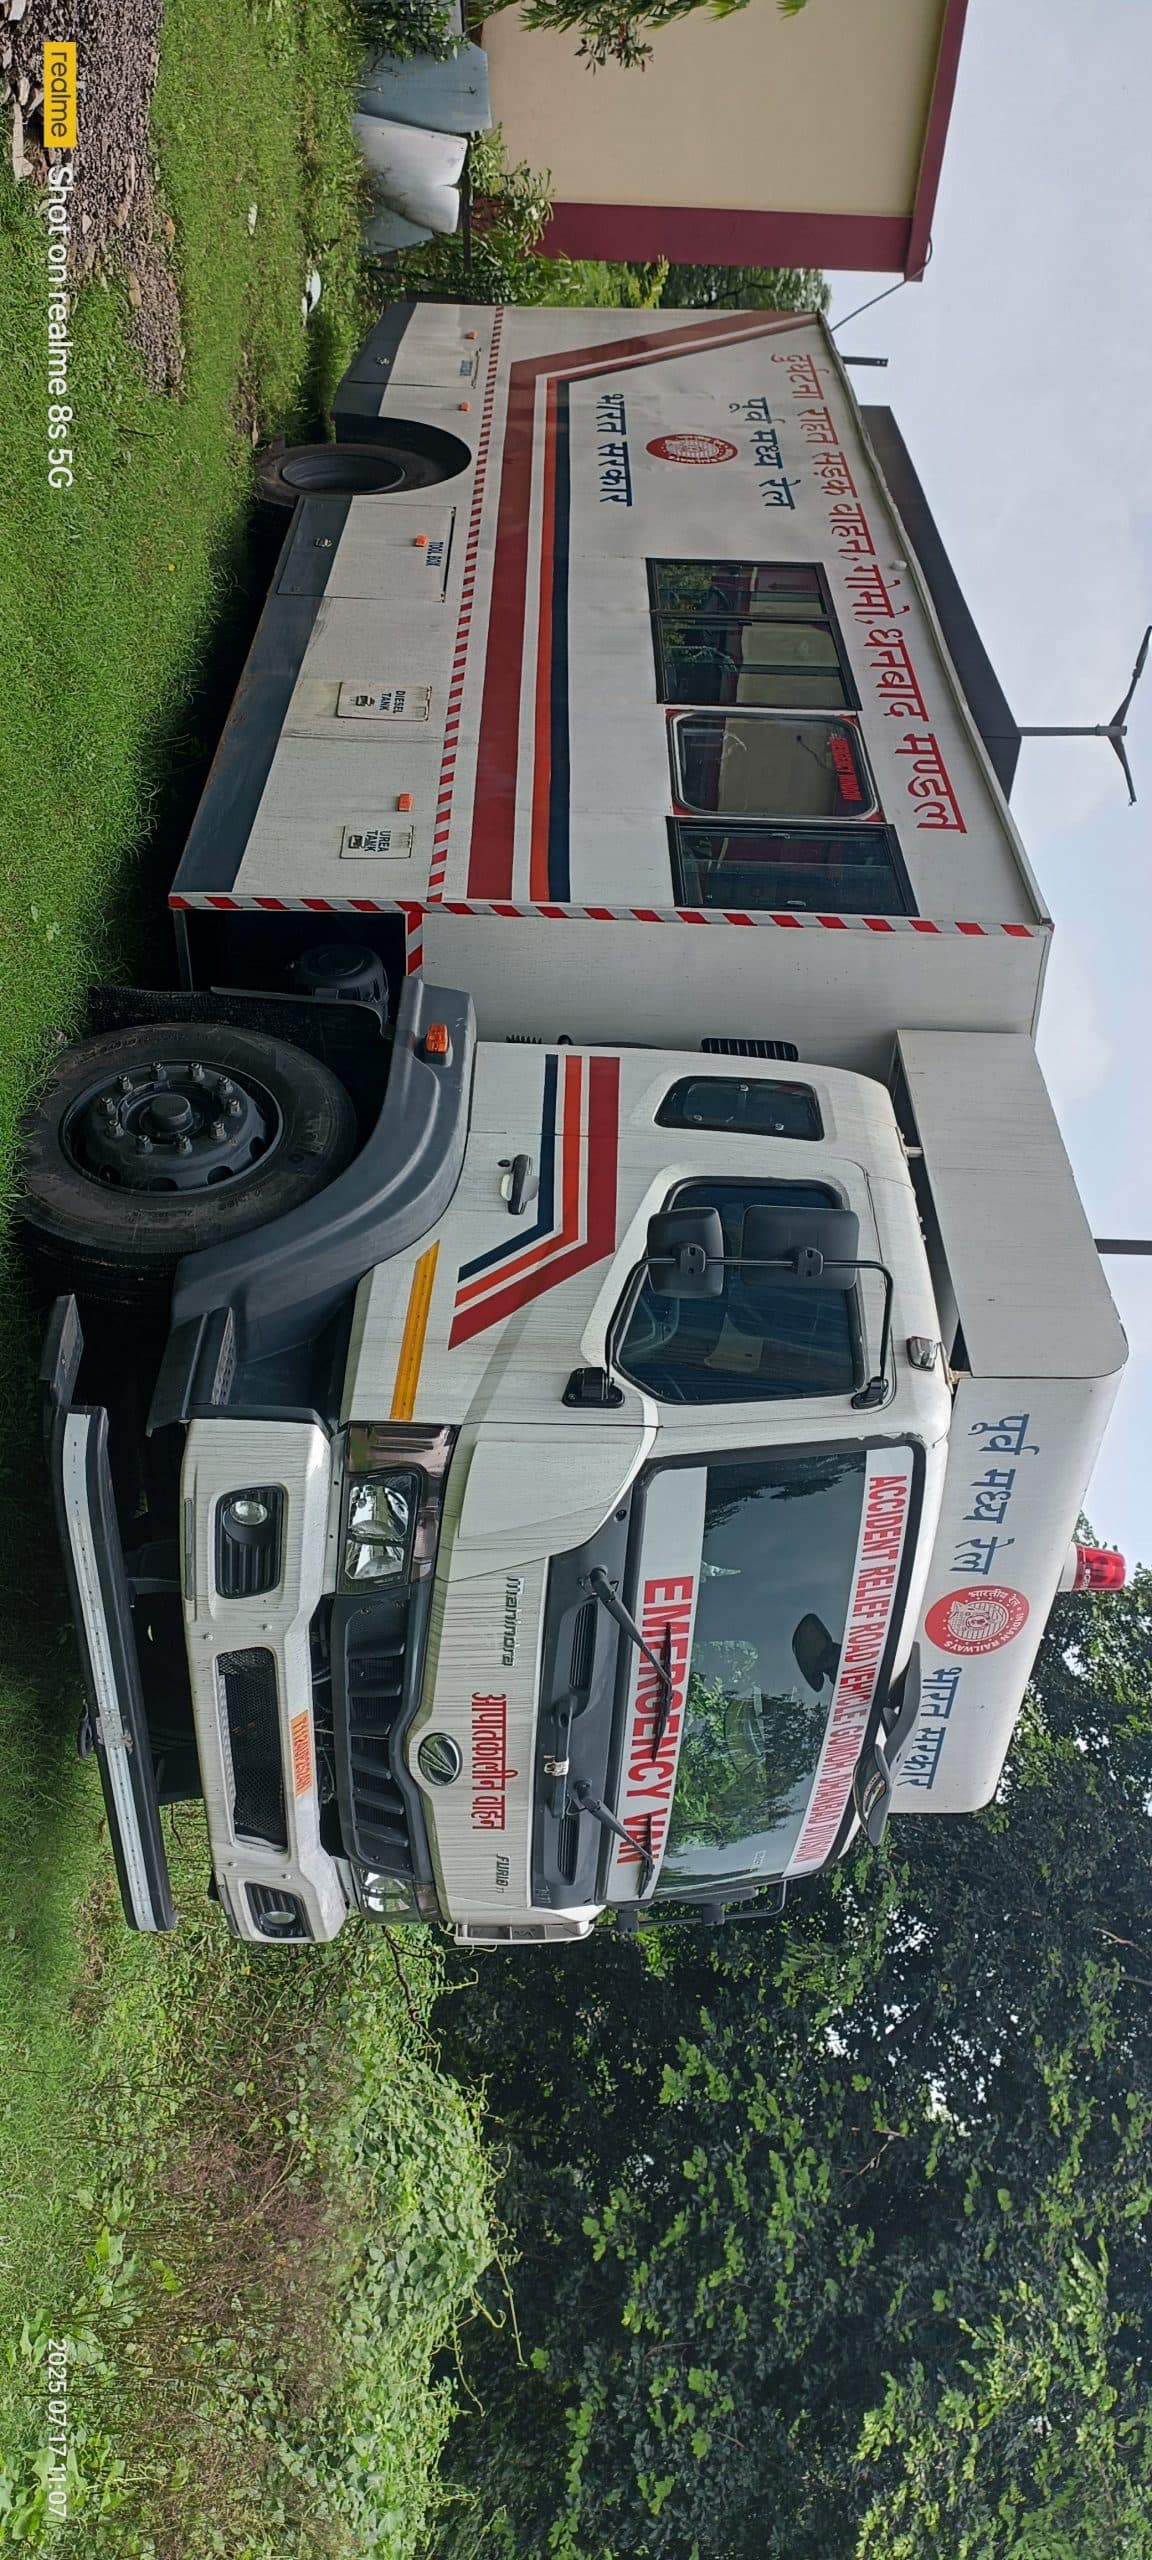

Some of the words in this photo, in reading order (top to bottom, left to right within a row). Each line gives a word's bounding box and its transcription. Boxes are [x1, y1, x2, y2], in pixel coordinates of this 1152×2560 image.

[771, 355, 829, 400] दुर्घटना
[596, 394, 627, 435] भारत
[729, 397, 786, 424] पूर्व
[797, 406, 839, 445] राहत
[750, 429, 784, 469] मध्य
[597, 441, 633, 507] सरकार
[759, 477, 801, 510] रेल
[812, 452, 858, 498] सड़क
[425, 556, 442, 566] BOX
[427, 542, 444, 554] TOOL
[863, 628, 929, 722] धनबाद
[379, 692, 392, 711] TANK
[393, 690, 406, 714] DIESEL
[828, 736, 855, 772] EMERGENCY
[894, 733, 968, 834] मण्डल
[364, 830, 378, 852] TANK
[377, 830, 391, 852] UREA
[968, 1414, 1039, 1456] पूर्व
[963, 1469, 1017, 1524] मध्य
[862, 1475, 908, 1561] ACCIDENT
[949, 1537, 1015, 1575] रेल
[852, 1564, 897, 1618] RELIEF
[844, 1621, 886, 1663] ROAD
[943, 1640, 1000, 1653] RAILWAYS
[1000, 1612, 1024, 1641] INDIAN
[626, 1575, 694, 1800] EMERGENCY
[919, 1667, 962, 1720] भारत
[471, 1692, 518, 1791] आपातकालीन
[896, 1727, 947, 1790] सरकार
[470, 1795, 506, 1830] वाहन
[808, 1774, 852, 1825] DHANBAD
[616, 1808, 668, 1864] VAN
[793, 1825, 838, 1864] DIVISION
[496, 1854, 510, 1887] FURIO
